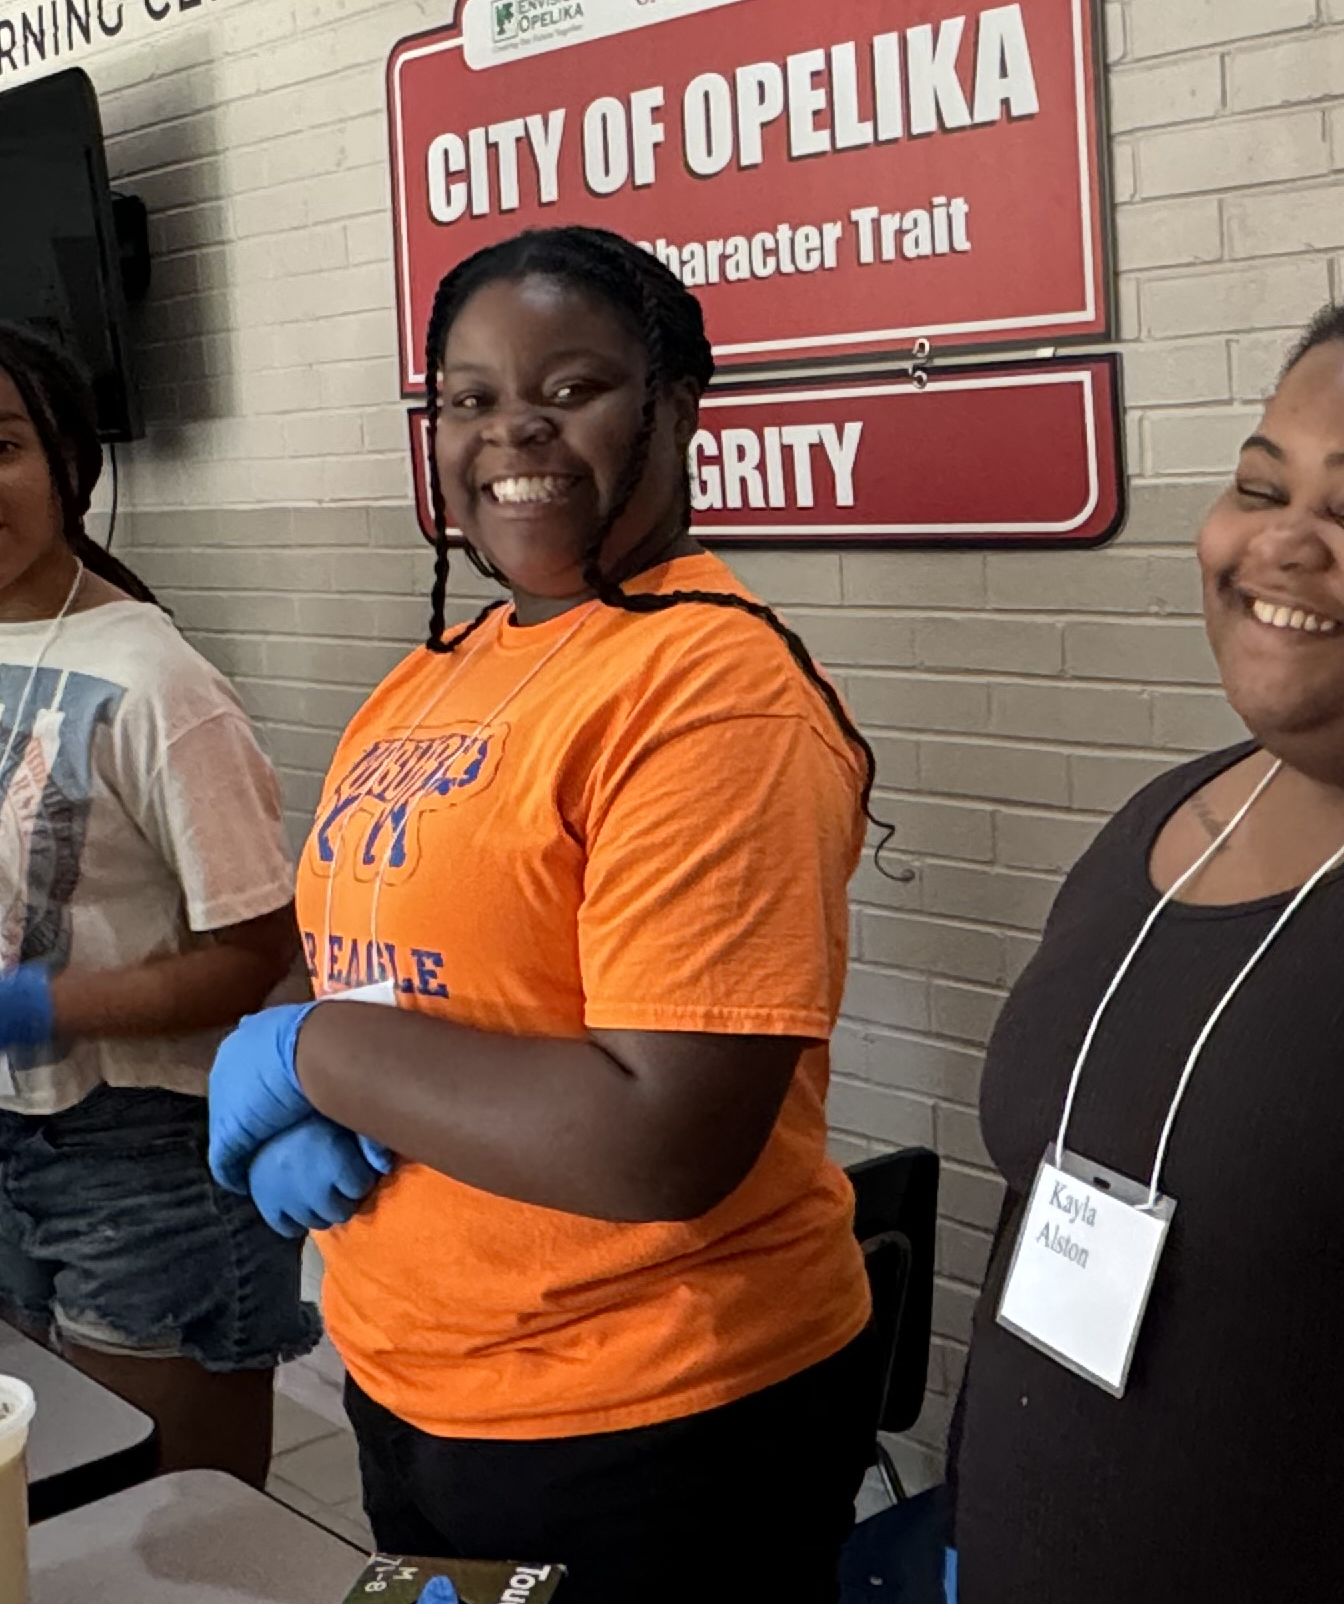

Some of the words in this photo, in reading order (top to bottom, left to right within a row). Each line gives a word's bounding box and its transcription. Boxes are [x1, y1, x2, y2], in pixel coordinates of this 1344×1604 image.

[519, 2, 584, 33] OPELIKA
[427, 108, 566, 224] CITY
[583, 86, 666, 195] OF
[683, 3, 1040, 176] OPELIKA
[850, 196, 971, 264] Trait
[687, 421, 863, 510] GRITY
[328, 934, 449, 999] EAGLE
[1049, 1180, 1097, 1227] Kayla
[1036, 1221, 1089, 1269] Alston
[498, 1564, 552, 1604] Tou
